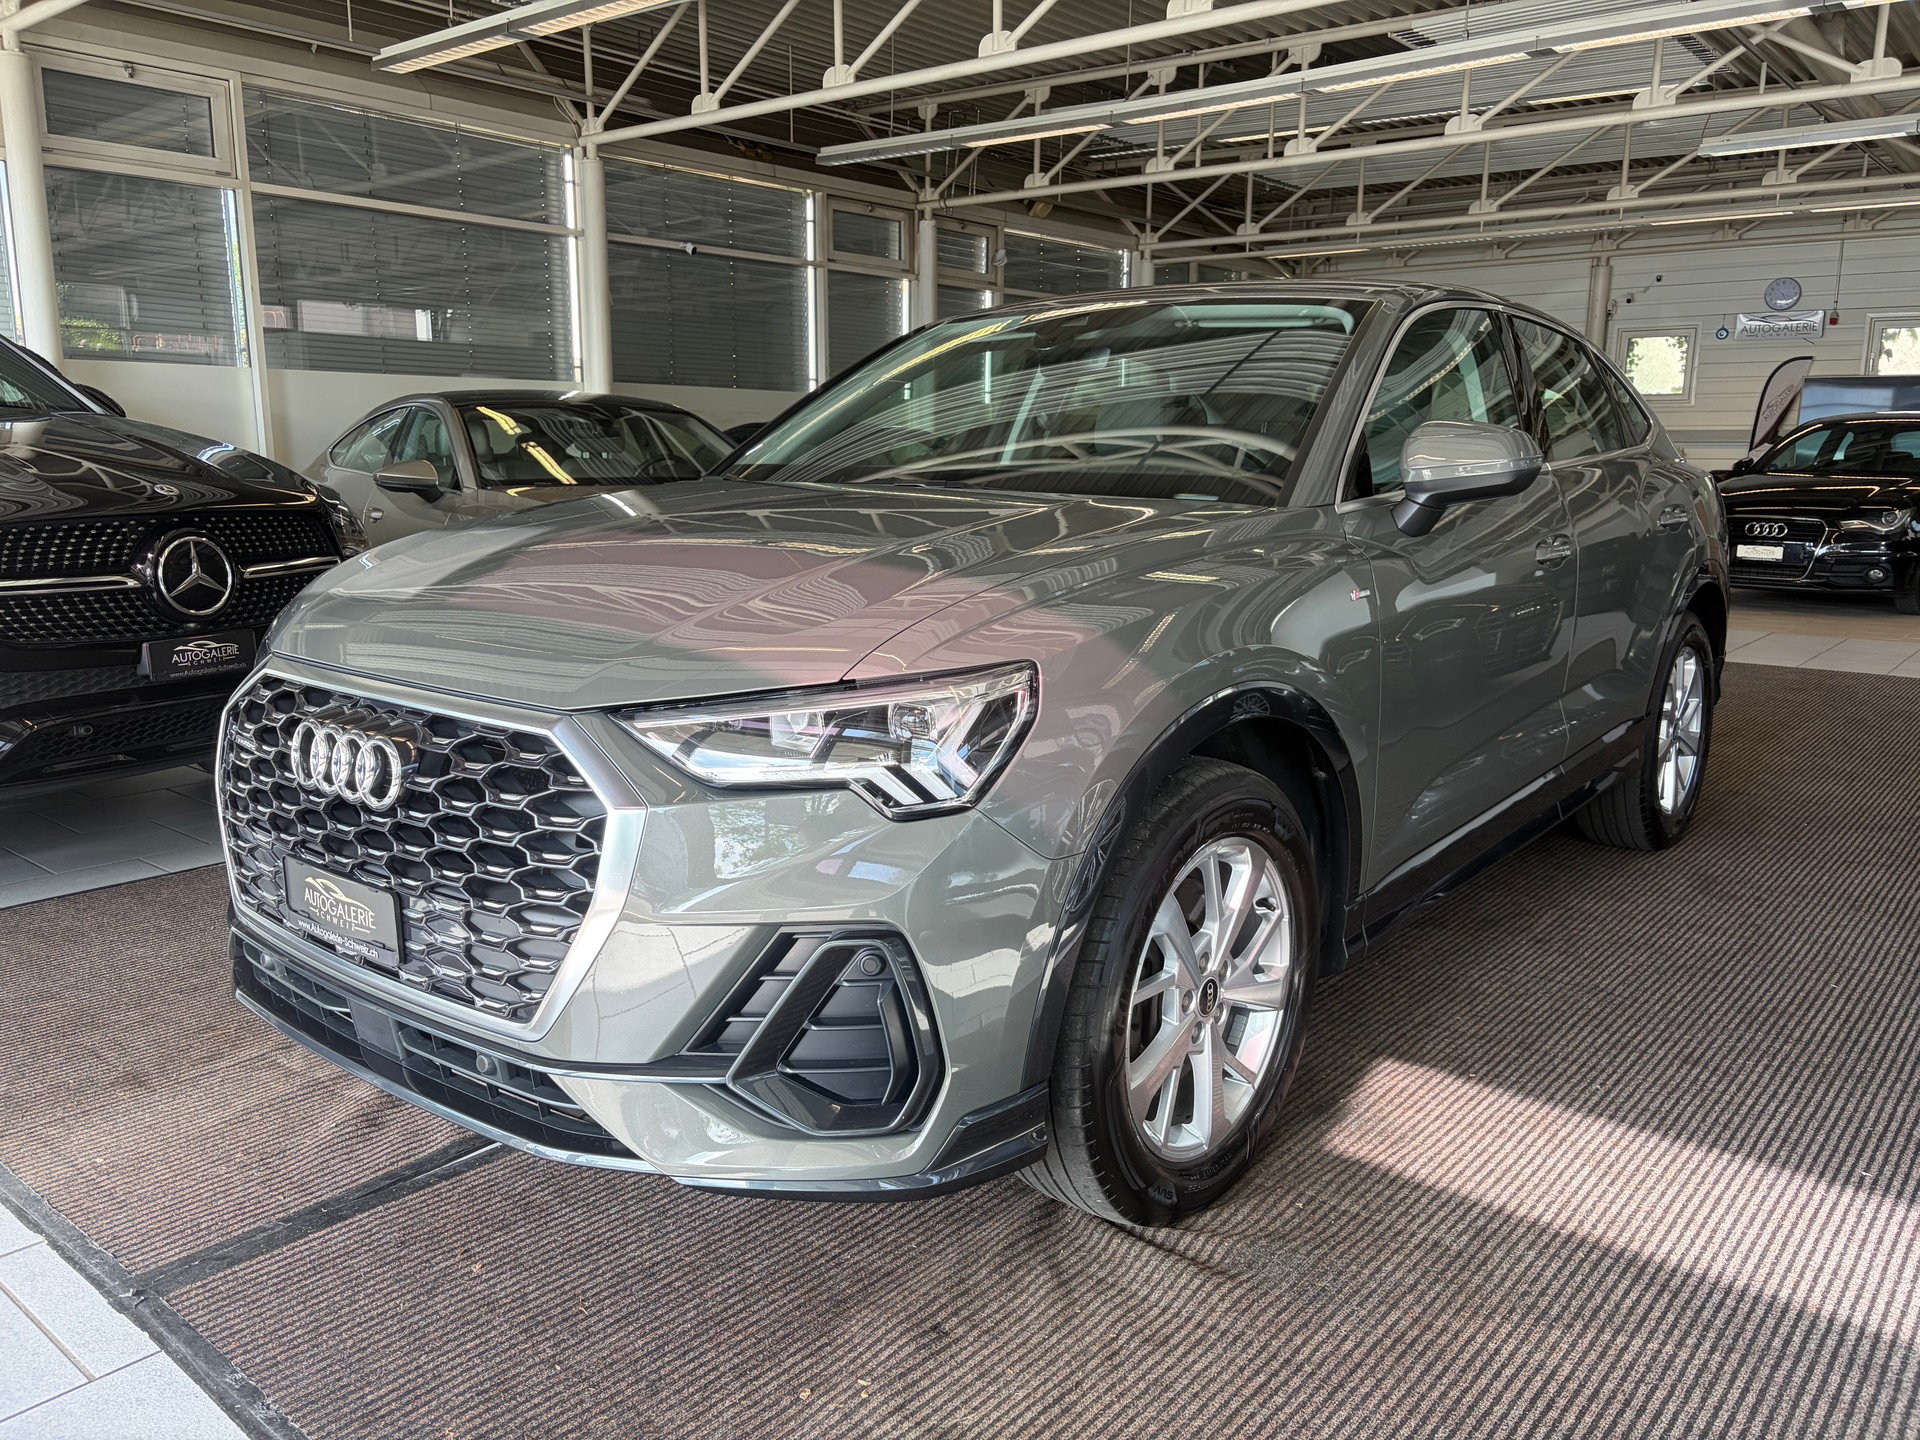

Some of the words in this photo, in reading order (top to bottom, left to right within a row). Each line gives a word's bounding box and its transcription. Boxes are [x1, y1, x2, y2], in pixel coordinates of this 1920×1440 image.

[1740, 322, 1818, 334] AUTOGALERIE
[172, 646, 239, 663] AUTOGALERIE
[304, 887, 376, 929] AUTOGALERIE
[316, 909, 356, 931] SCHWEIZ
[298, 919, 379, 959] www.Autogalerie-Schweiz.ch
[1153, 1186, 1174, 1200] SUV
